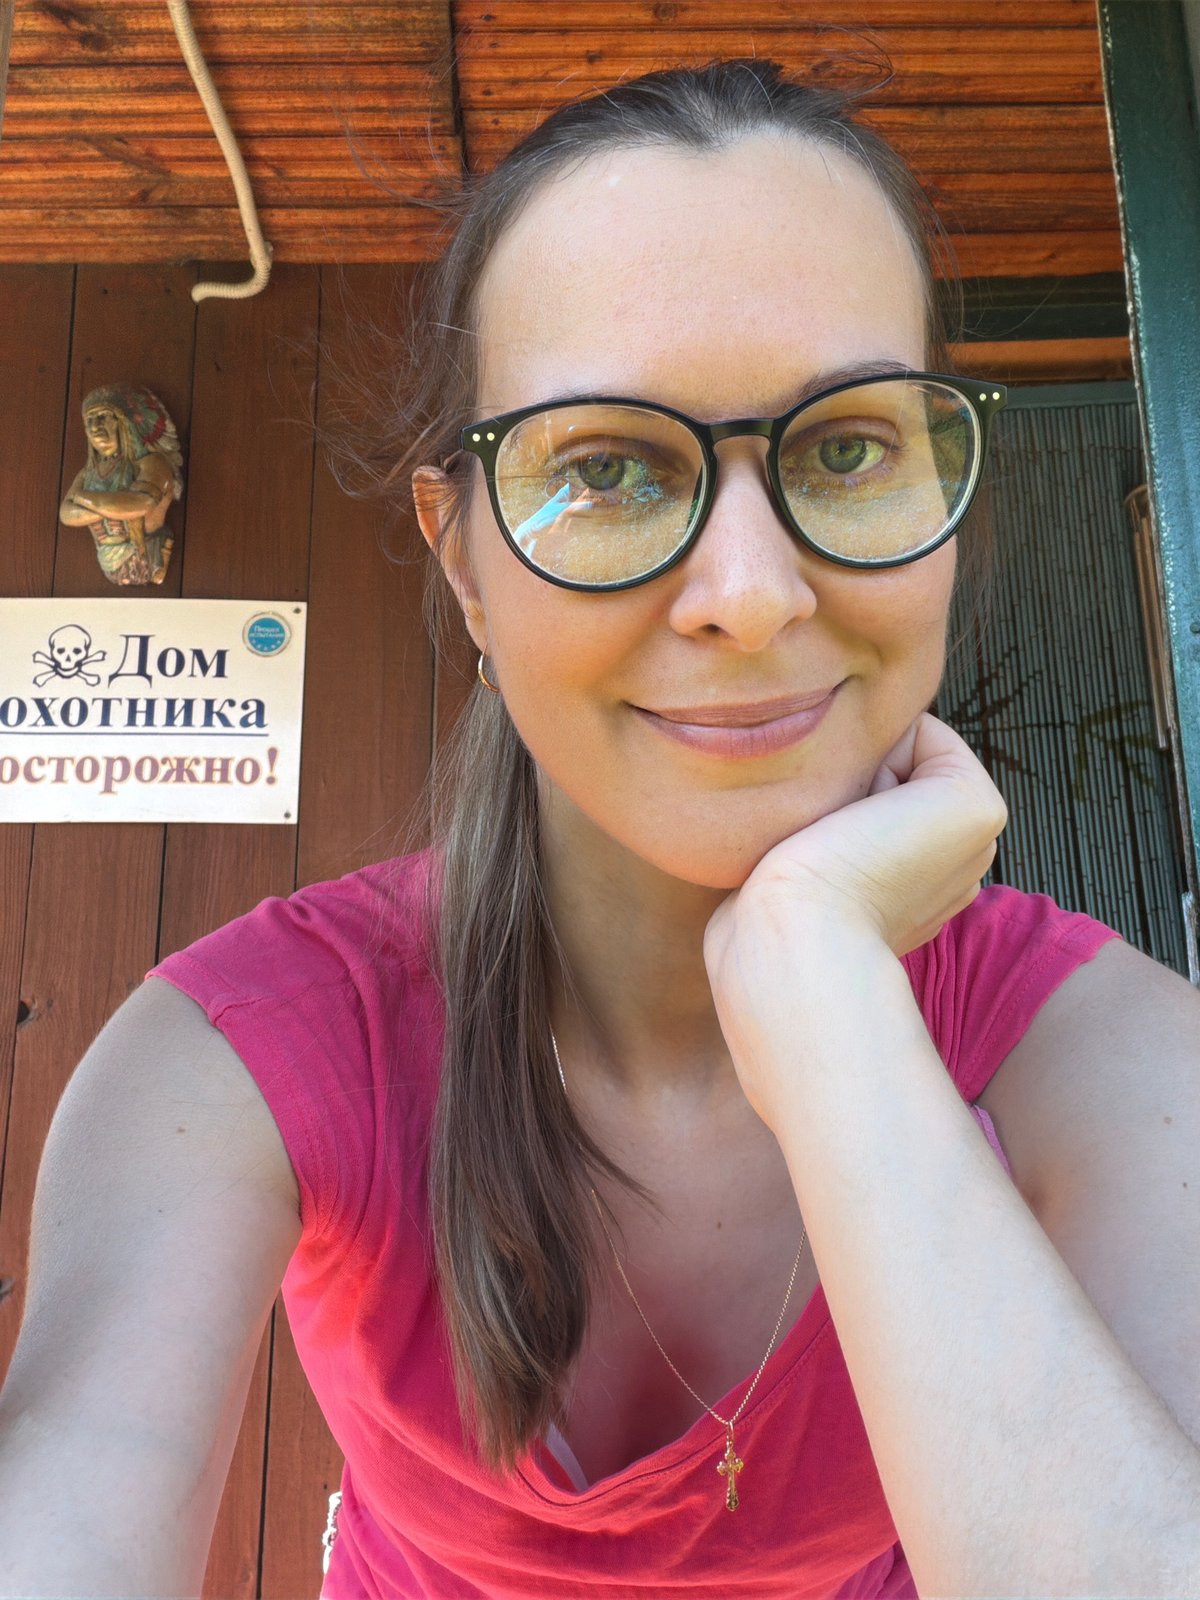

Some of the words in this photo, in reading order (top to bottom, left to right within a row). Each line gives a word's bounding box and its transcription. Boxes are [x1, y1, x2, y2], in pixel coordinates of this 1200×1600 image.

[107, 634, 230, 689] Дом
[0, 696, 269, 729] охотника
[0, 747, 279, 795] осторожно!
